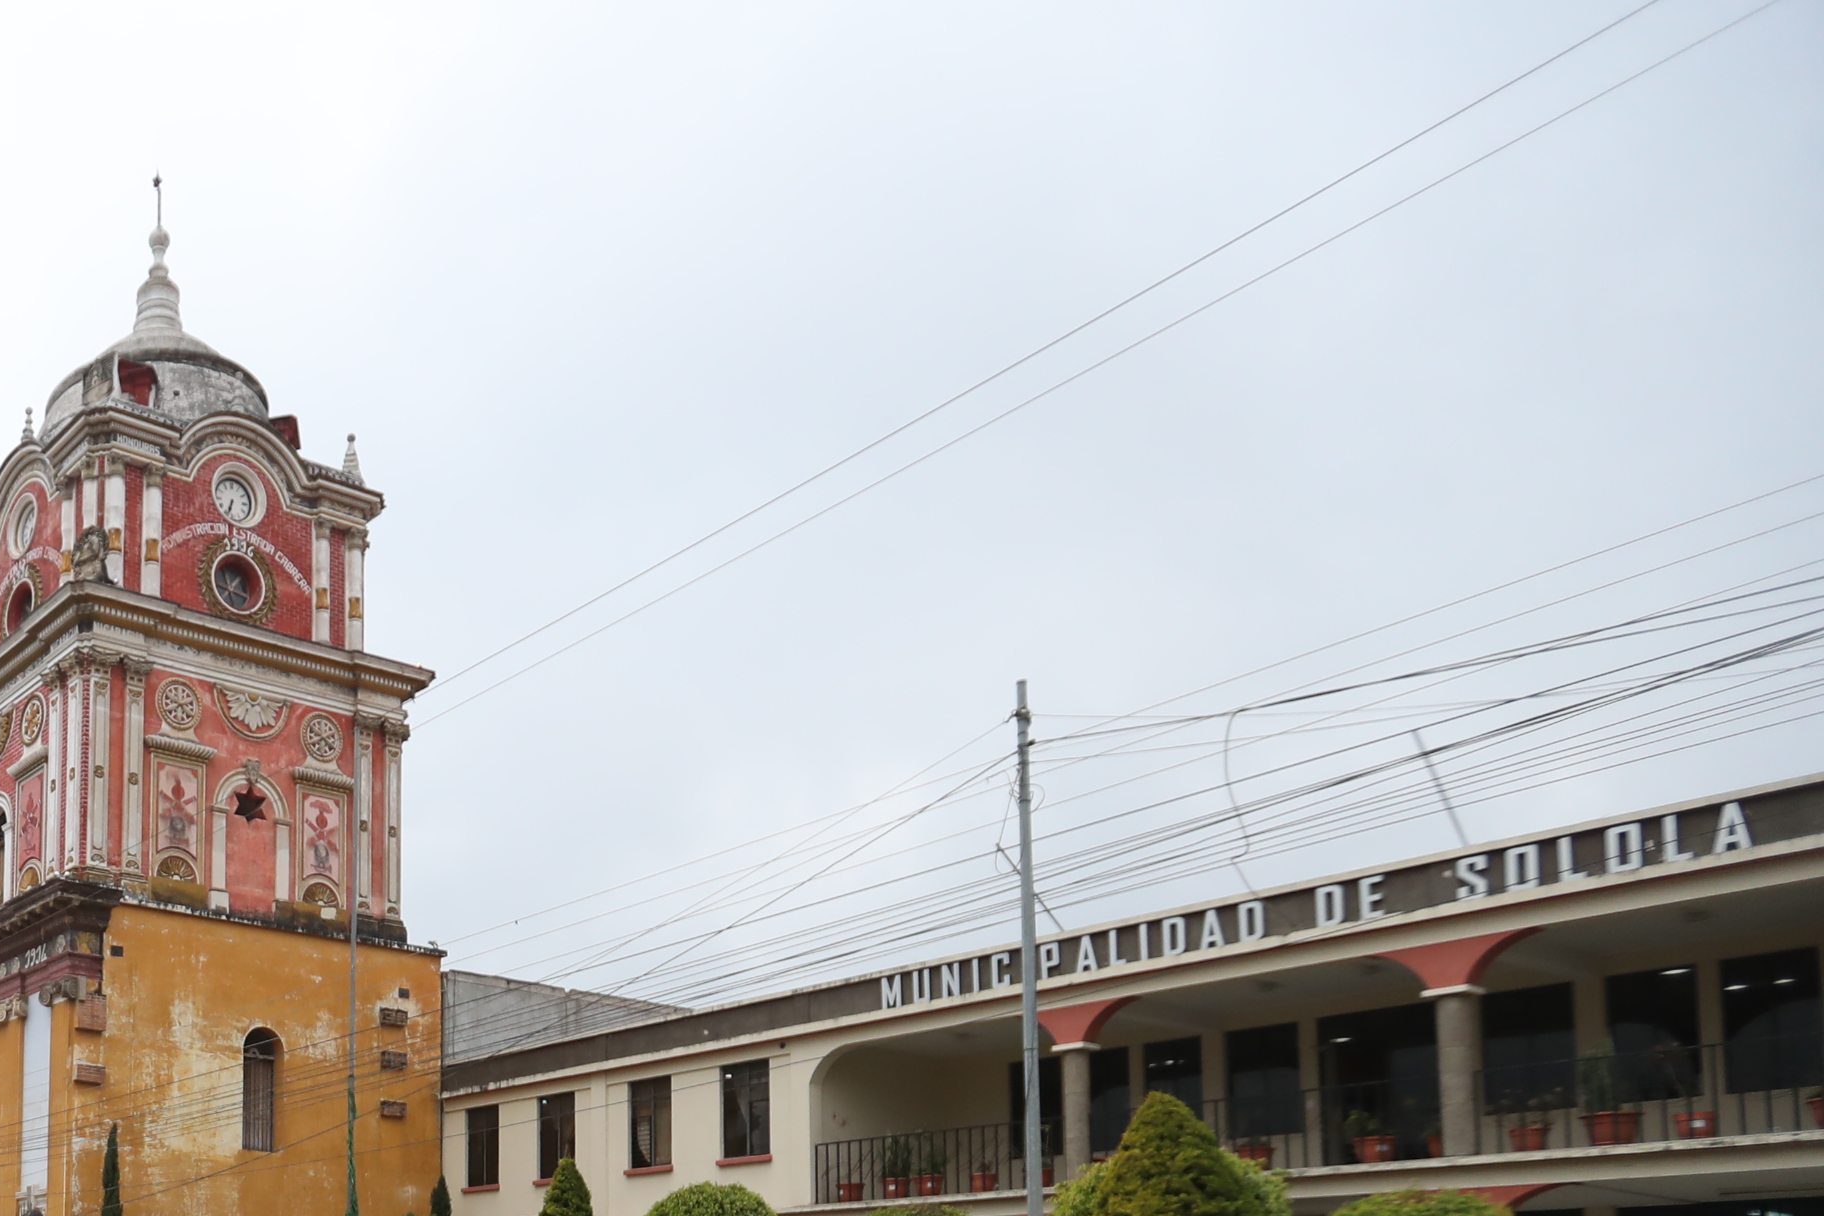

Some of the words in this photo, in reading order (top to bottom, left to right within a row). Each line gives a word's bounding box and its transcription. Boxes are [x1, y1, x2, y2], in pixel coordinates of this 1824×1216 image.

[117, 433, 161, 456] HONDURAS
[233, 527, 275, 555] ESTRADA
[275, 551, 312, 595] CABRERA
[881, 900, 1266, 1009] MUNICPALIDAD
[1314, 874, 1387, 928] DE
[1455, 801, 1753, 900] SOLOLA
[25, 943, 48, 969] 1914
